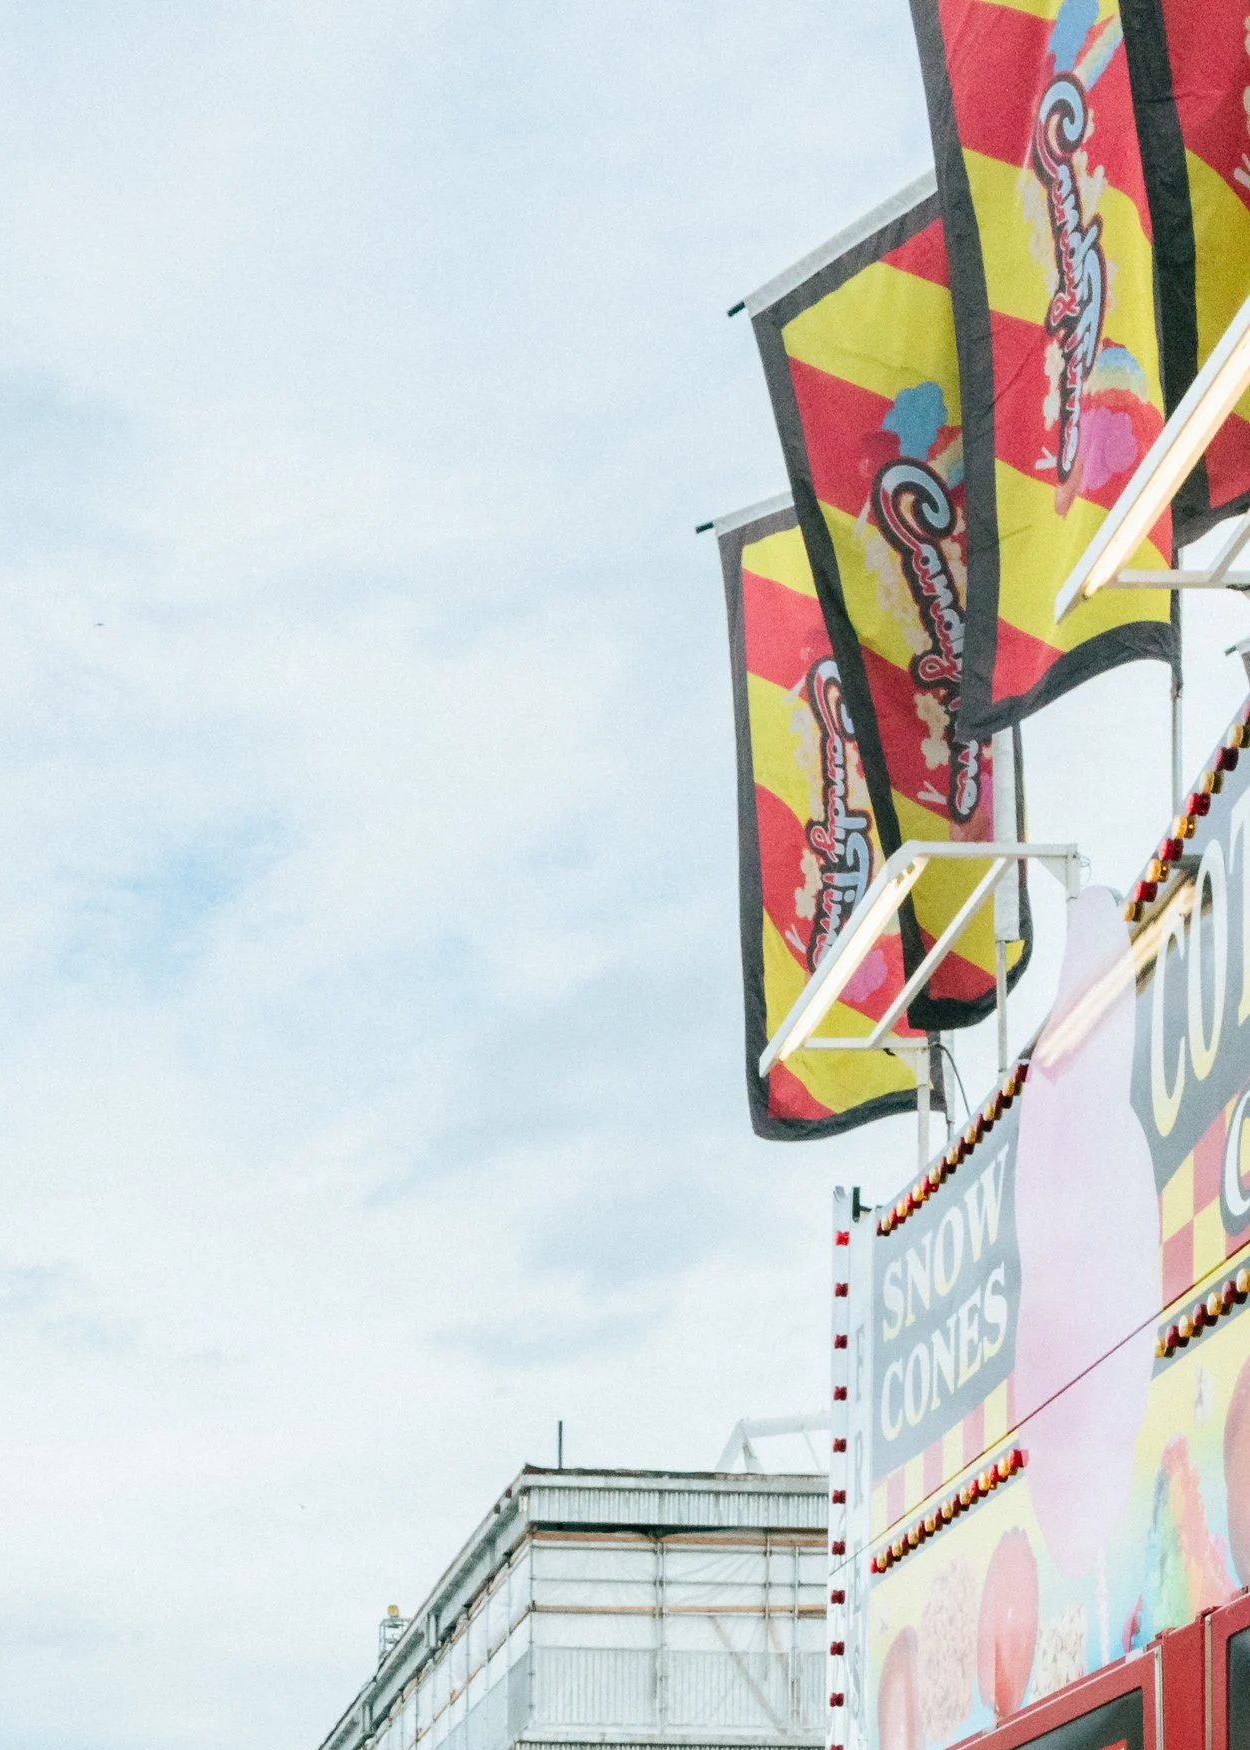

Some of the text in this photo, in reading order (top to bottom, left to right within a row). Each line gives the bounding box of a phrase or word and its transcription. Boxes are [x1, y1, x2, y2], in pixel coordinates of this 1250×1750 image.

[1034, 74, 1105, 327] Candy
[882, 1143, 1009, 1342] SNOW
[880, 1264, 1008, 1440] CONES
